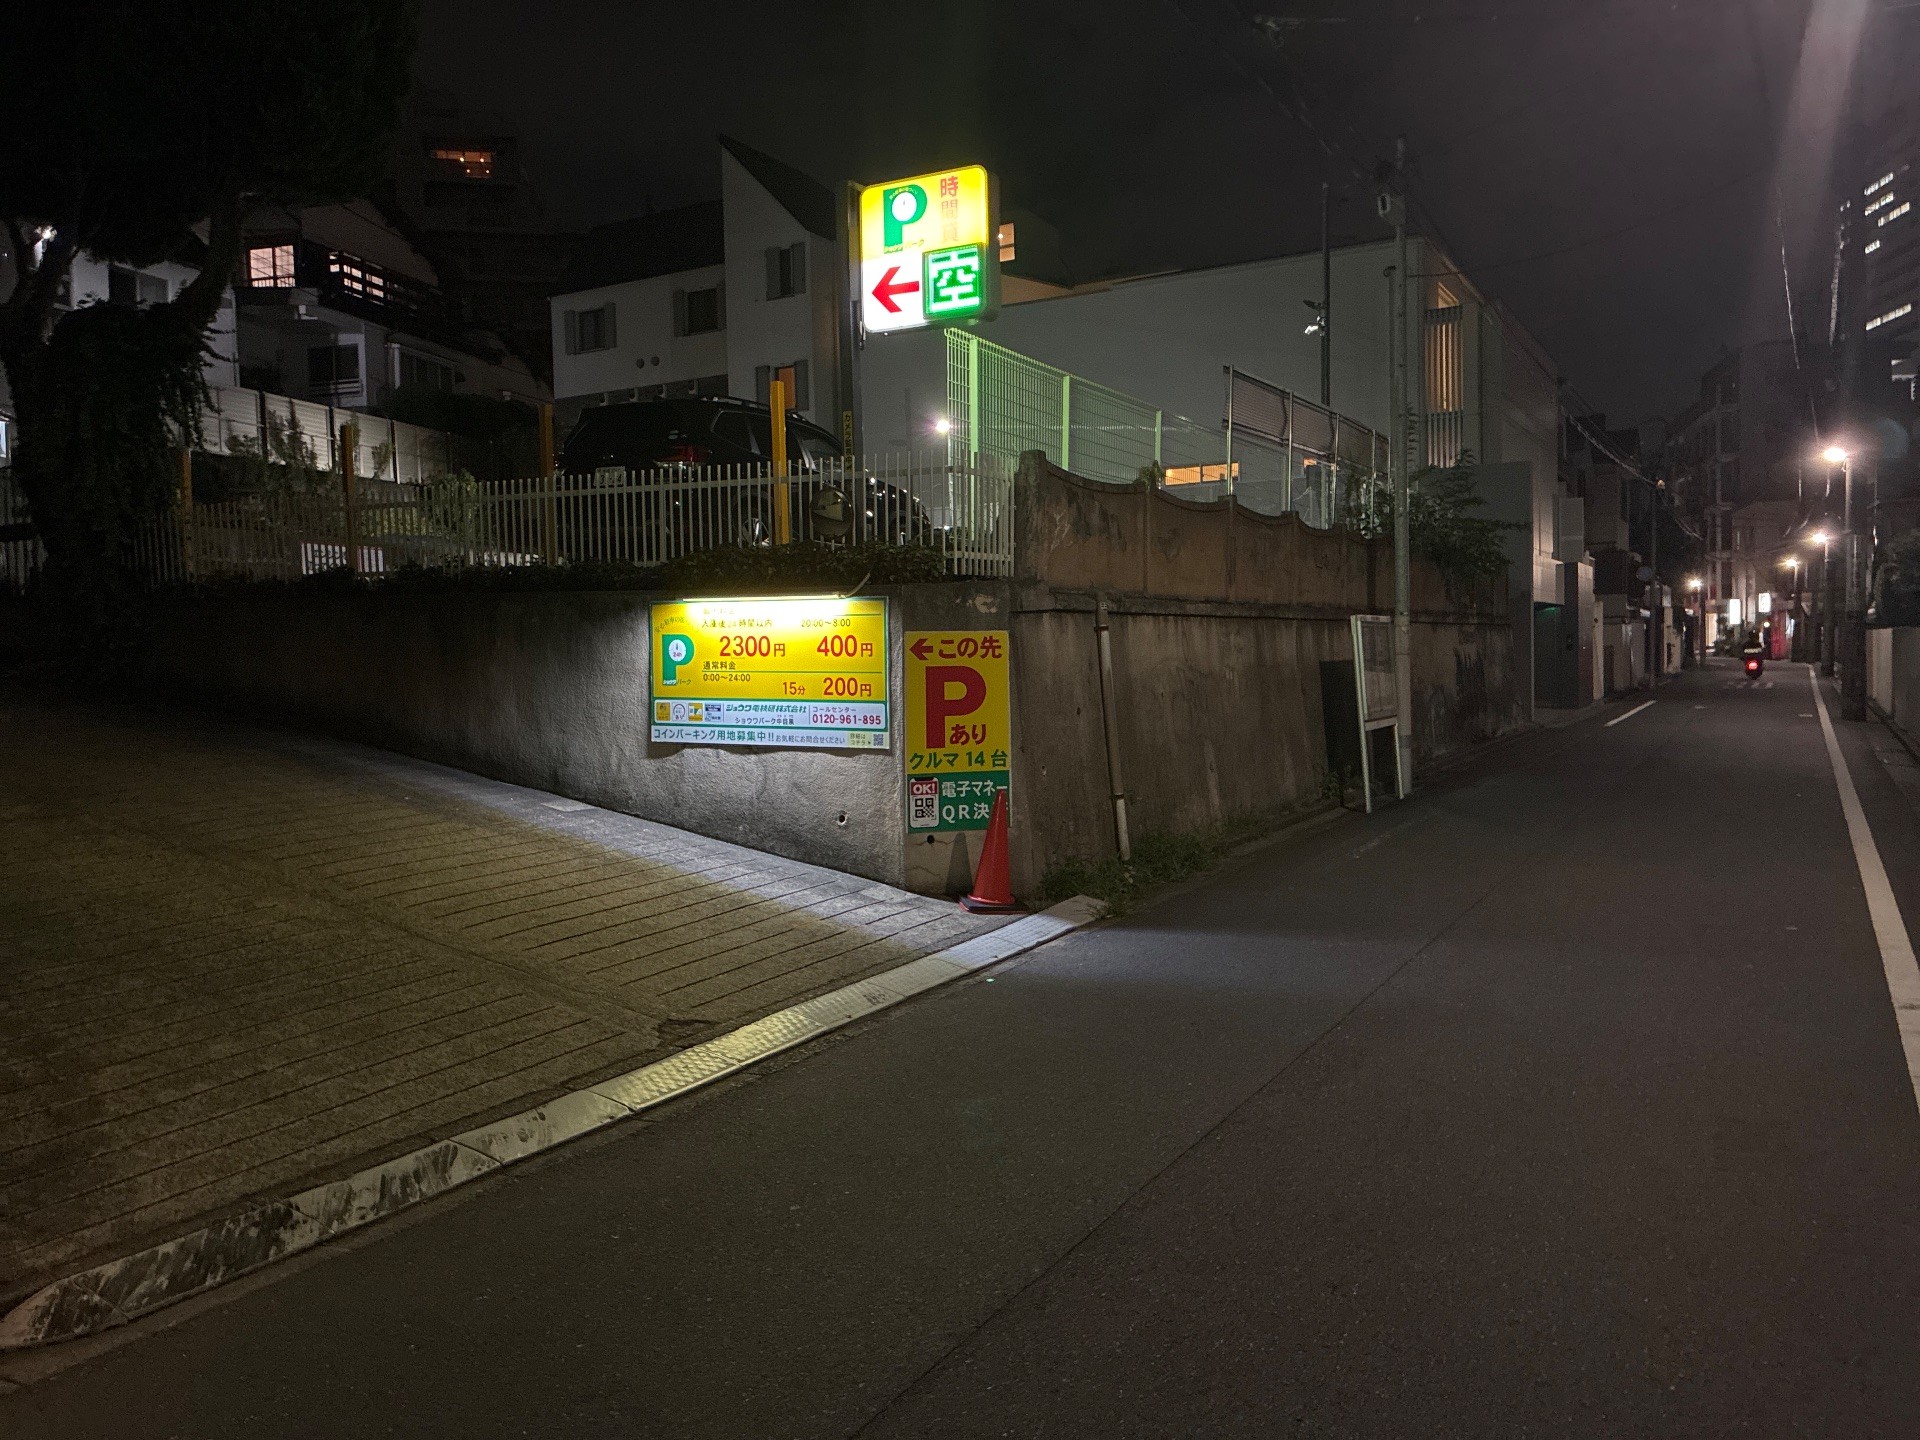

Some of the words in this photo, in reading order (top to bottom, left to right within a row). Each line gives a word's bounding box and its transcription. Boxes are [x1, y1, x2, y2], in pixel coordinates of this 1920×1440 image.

[928, 249, 981, 313] 空
[719, 635, 786, 657] 2300円
[817, 634, 873, 657] 400円
[938, 635, 1003, 659] この先
[703, 661, 736, 670] 通常料金
[782, 681, 806, 695] 15分
[823, 677, 872, 697] 200円
[925, 666, 987, 749] P
[812, 713, 882, 725] 0120-961-895
[949, 723, 987, 746] あり
[912, 783, 936, 795] OK!
[941, 780, 1008, 798] 電子マネー
[942, 802, 1008, 824] QR決
